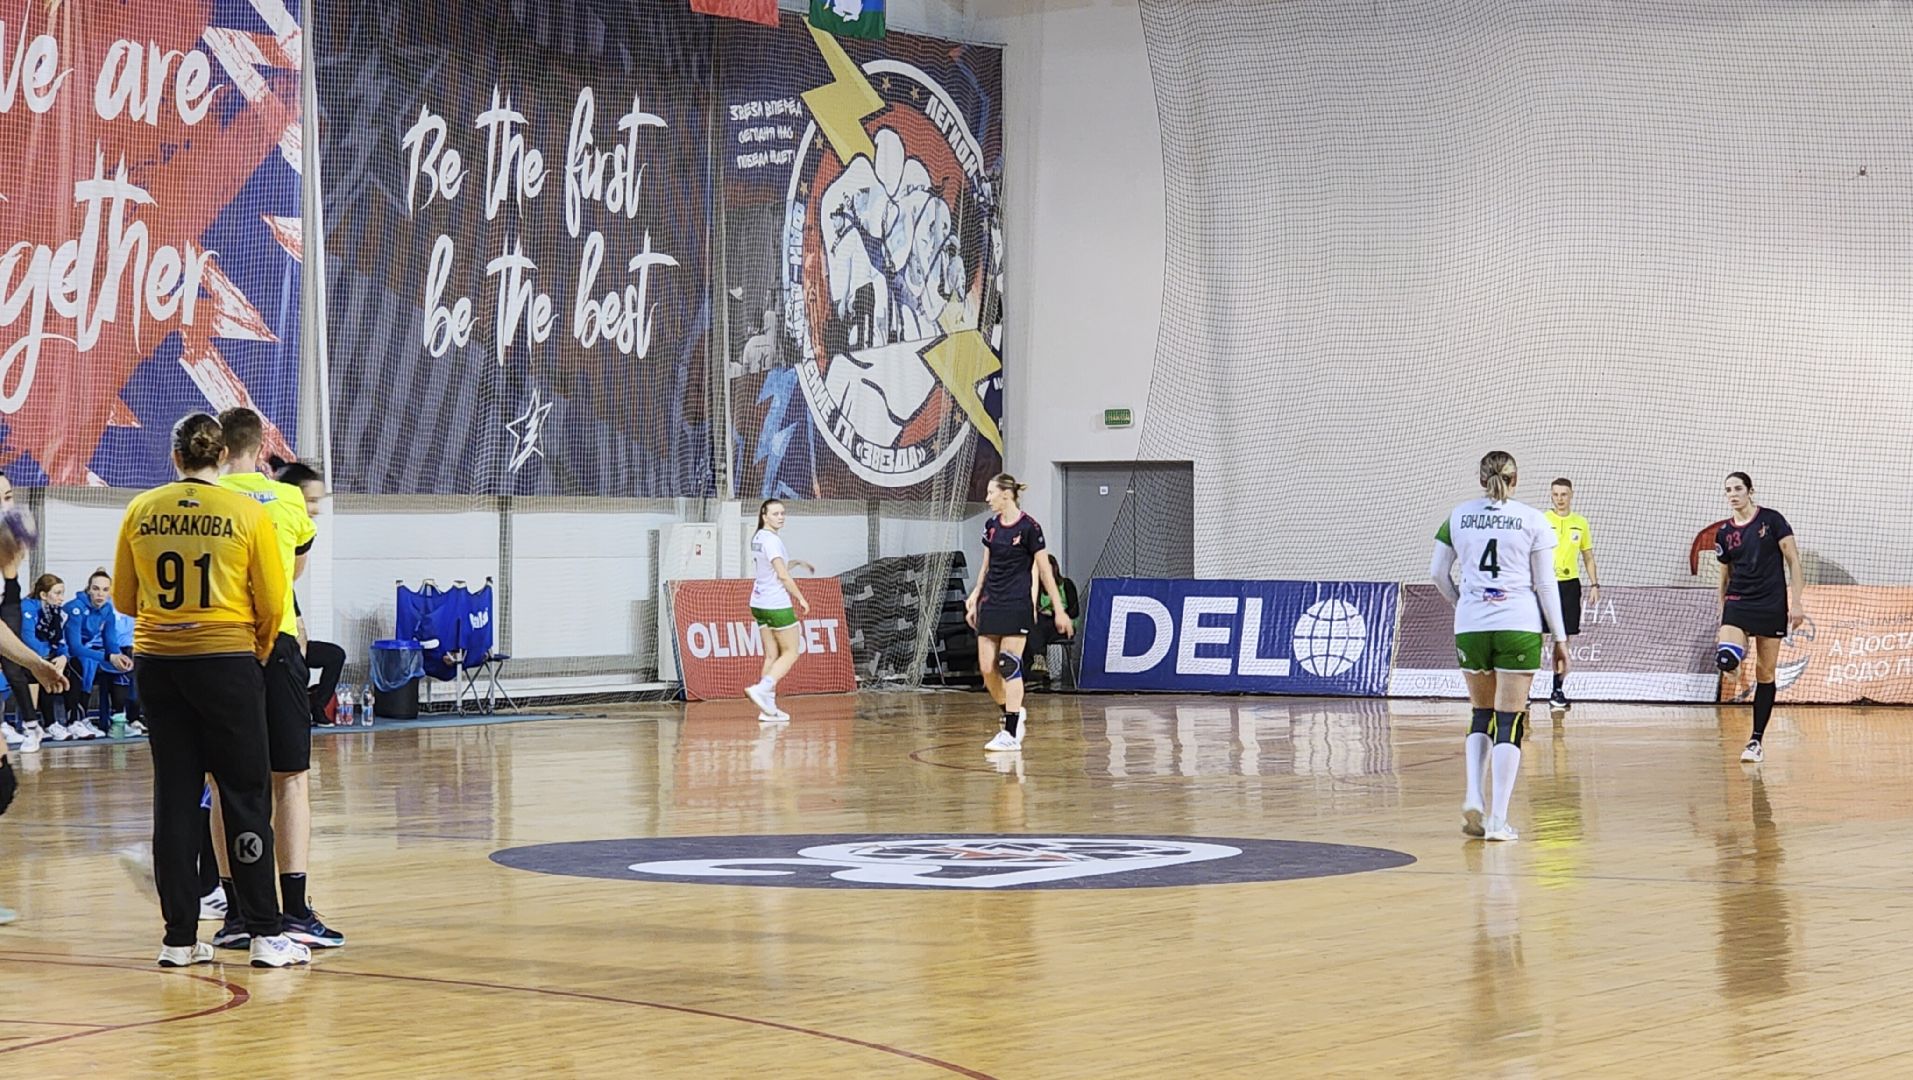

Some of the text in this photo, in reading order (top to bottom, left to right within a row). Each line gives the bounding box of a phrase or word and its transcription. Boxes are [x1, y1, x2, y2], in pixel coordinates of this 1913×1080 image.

[95, 38, 224, 126] are
[402, 83, 669, 238] Be the first
[924, 94, 979, 179] ЛЕГИОН
[0, 139, 220, 414] gether
[424, 228, 681, 367] be the best
[140, 514, 233, 538] БАСКАКОВА
[1460, 514, 1523, 530] БОНДАРЕНКО
[1725, 530, 1742, 549] 23
[156, 551, 212, 610] 91
[1479, 538, 1501, 579] 4
[1827, 660, 1890, 686] ДОДО
